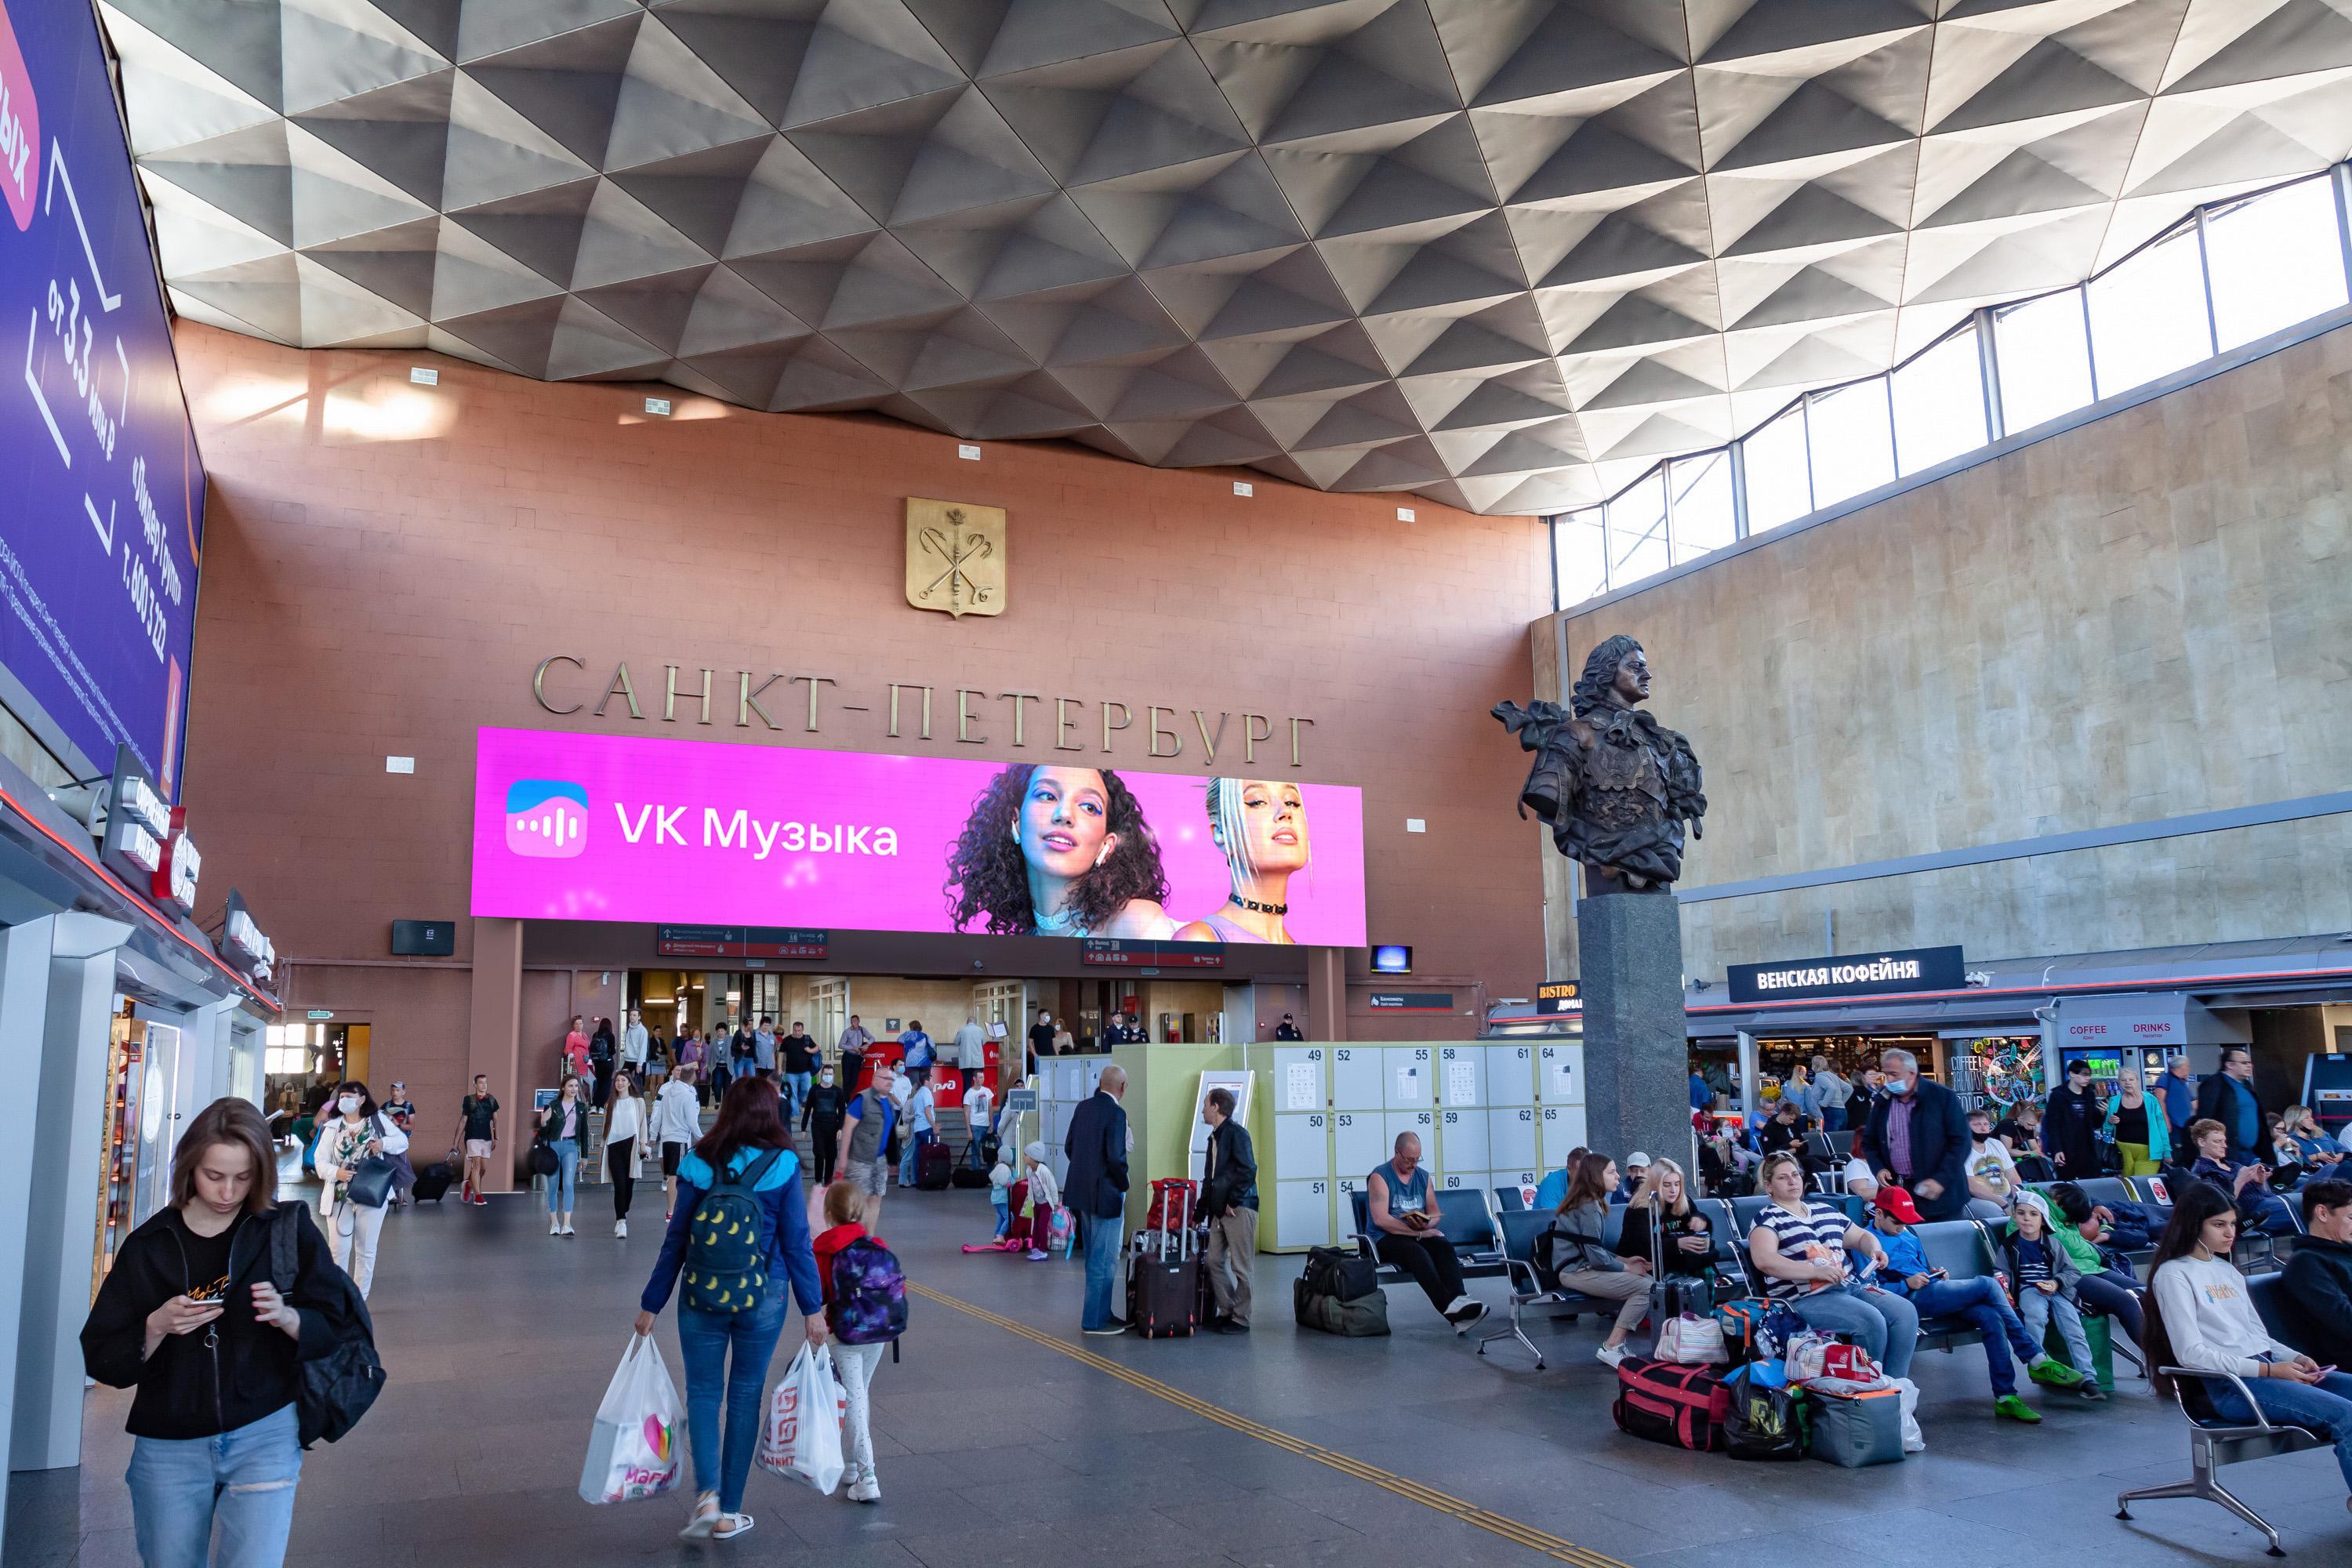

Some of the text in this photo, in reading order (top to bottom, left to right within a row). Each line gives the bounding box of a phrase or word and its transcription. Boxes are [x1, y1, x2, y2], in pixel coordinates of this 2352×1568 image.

[0, 70, 31, 201] ых
[48, 278, 64, 336] от
[64, 277, 93, 397] 3,3
[88, 383, 108, 452] млн
[131, 553, 148, 624] 600
[147, 587, 155, 637] 3
[152, 601, 167, 665] 222
[615, 802, 898, 861] VK Музыка
[1757, 957, 1920, 989] ВЕНСКАЯ КОФЕЙНЯ
[1539, 985, 1576, 999] BISTRO
[2070, 1025, 2107, 1035] COFFEE
[2133, 1023, 2171, 1033] DRINKS
[1308, 1050, 1321, 1061] 49
[1338, 1050, 1351, 1061] 52
[1415, 1050, 1428, 1060] 55
[1443, 1049, 1455, 1059] 58
[1518, 1048, 1529, 1058] 61
[1542, 1047, 1554, 1058] 64
[1951, 1055, 1982, 1071] COFFEE!
[1957, 1095, 1984, 1112] OUP
[1417, 1113, 1430, 1124] 56
[1446, 1112, 1457, 1123] 59
[1519, 1110, 1531, 1121] 62
[1544, 1109, 1557, 1120] 65
[1310, 1116, 1323, 1127] 50
[1339, 1115, 1352, 1126] 53
[1447, 1176, 1460, 1188] 60
[1522, 1173, 1534, 1184] 63
[1312, 1182, 1324, 1194] 51
[1341, 1181, 1354, 1192] 54
